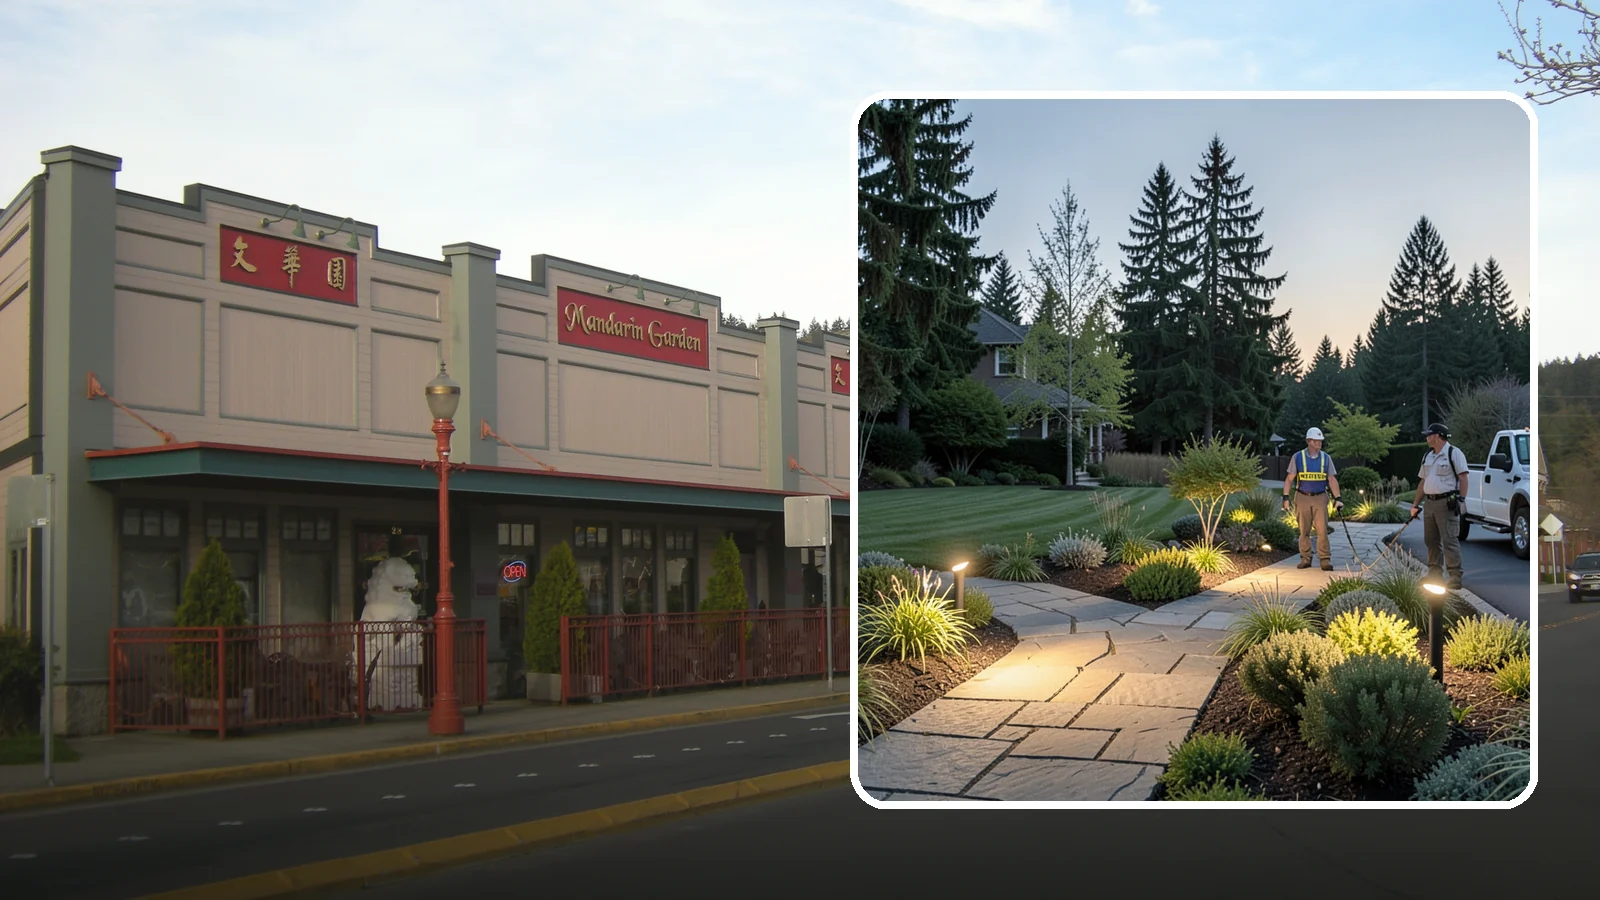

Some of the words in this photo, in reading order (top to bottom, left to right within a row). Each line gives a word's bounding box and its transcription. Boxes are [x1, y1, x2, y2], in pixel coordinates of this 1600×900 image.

[231, 236, 346, 291] 文華園
[565, 302, 644, 341] Mandarin
[648, 320, 701, 352] Garden
[503, 565, 527, 578] OPEN
